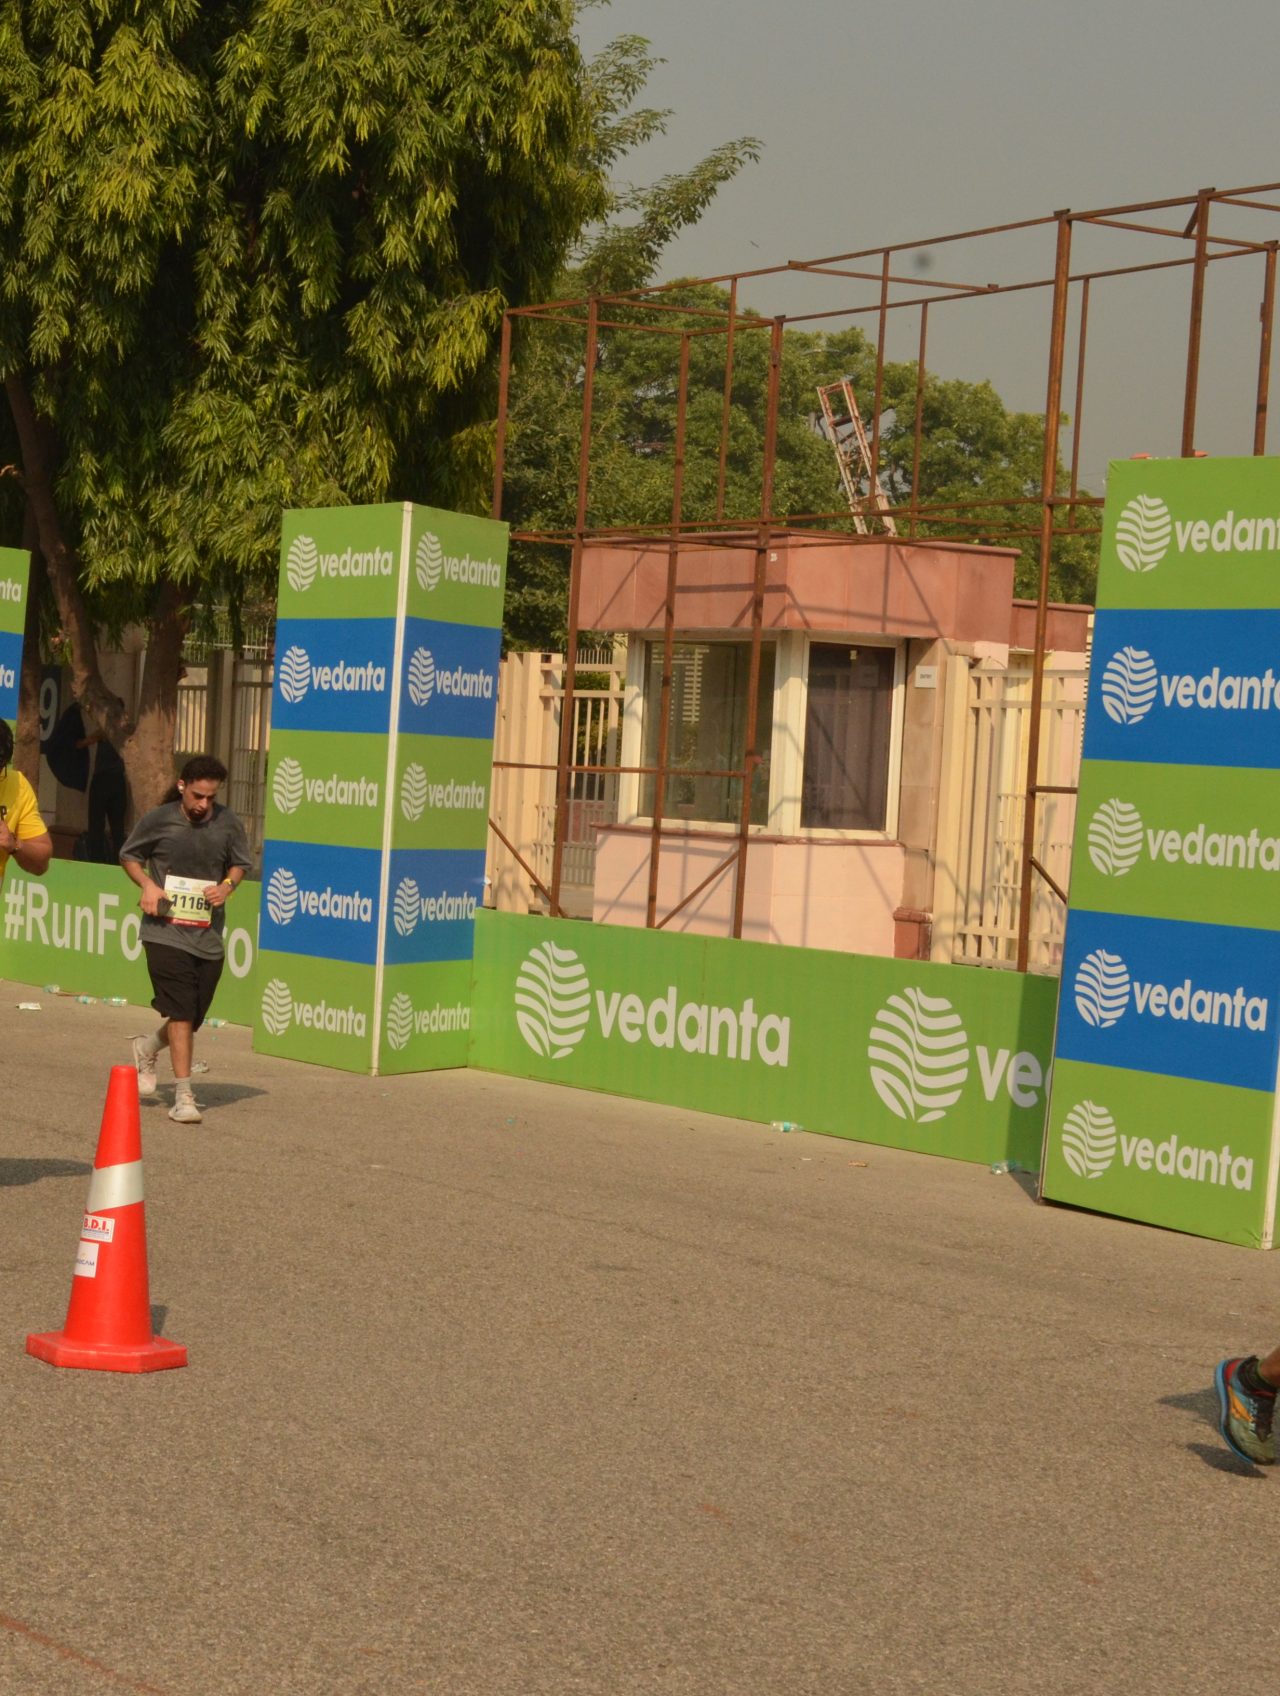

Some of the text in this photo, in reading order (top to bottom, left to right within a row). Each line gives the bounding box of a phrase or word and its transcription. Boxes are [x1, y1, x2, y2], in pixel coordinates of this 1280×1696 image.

[319, 546, 393, 577] vedanta
[443, 553, 501, 588] vedanta
[311, 660, 386, 691] vedanta
[435, 666, 493, 698] vedanta
[305, 774, 379, 807] vedanta
[428, 779, 485, 810] vedanta
[1147, 823, 1280, 871] vedanta
[299, 887, 372, 922] vedanta
[420, 892, 477, 921] vedanta
[293, 1000, 366, 1037] vedanta
[413, 1002, 470, 1034] vedanta
[1133, 979, 1268, 1032] vedanta
[596, 986, 790, 1067] vedanta
[1120, 1134, 1254, 1191] vedanta
